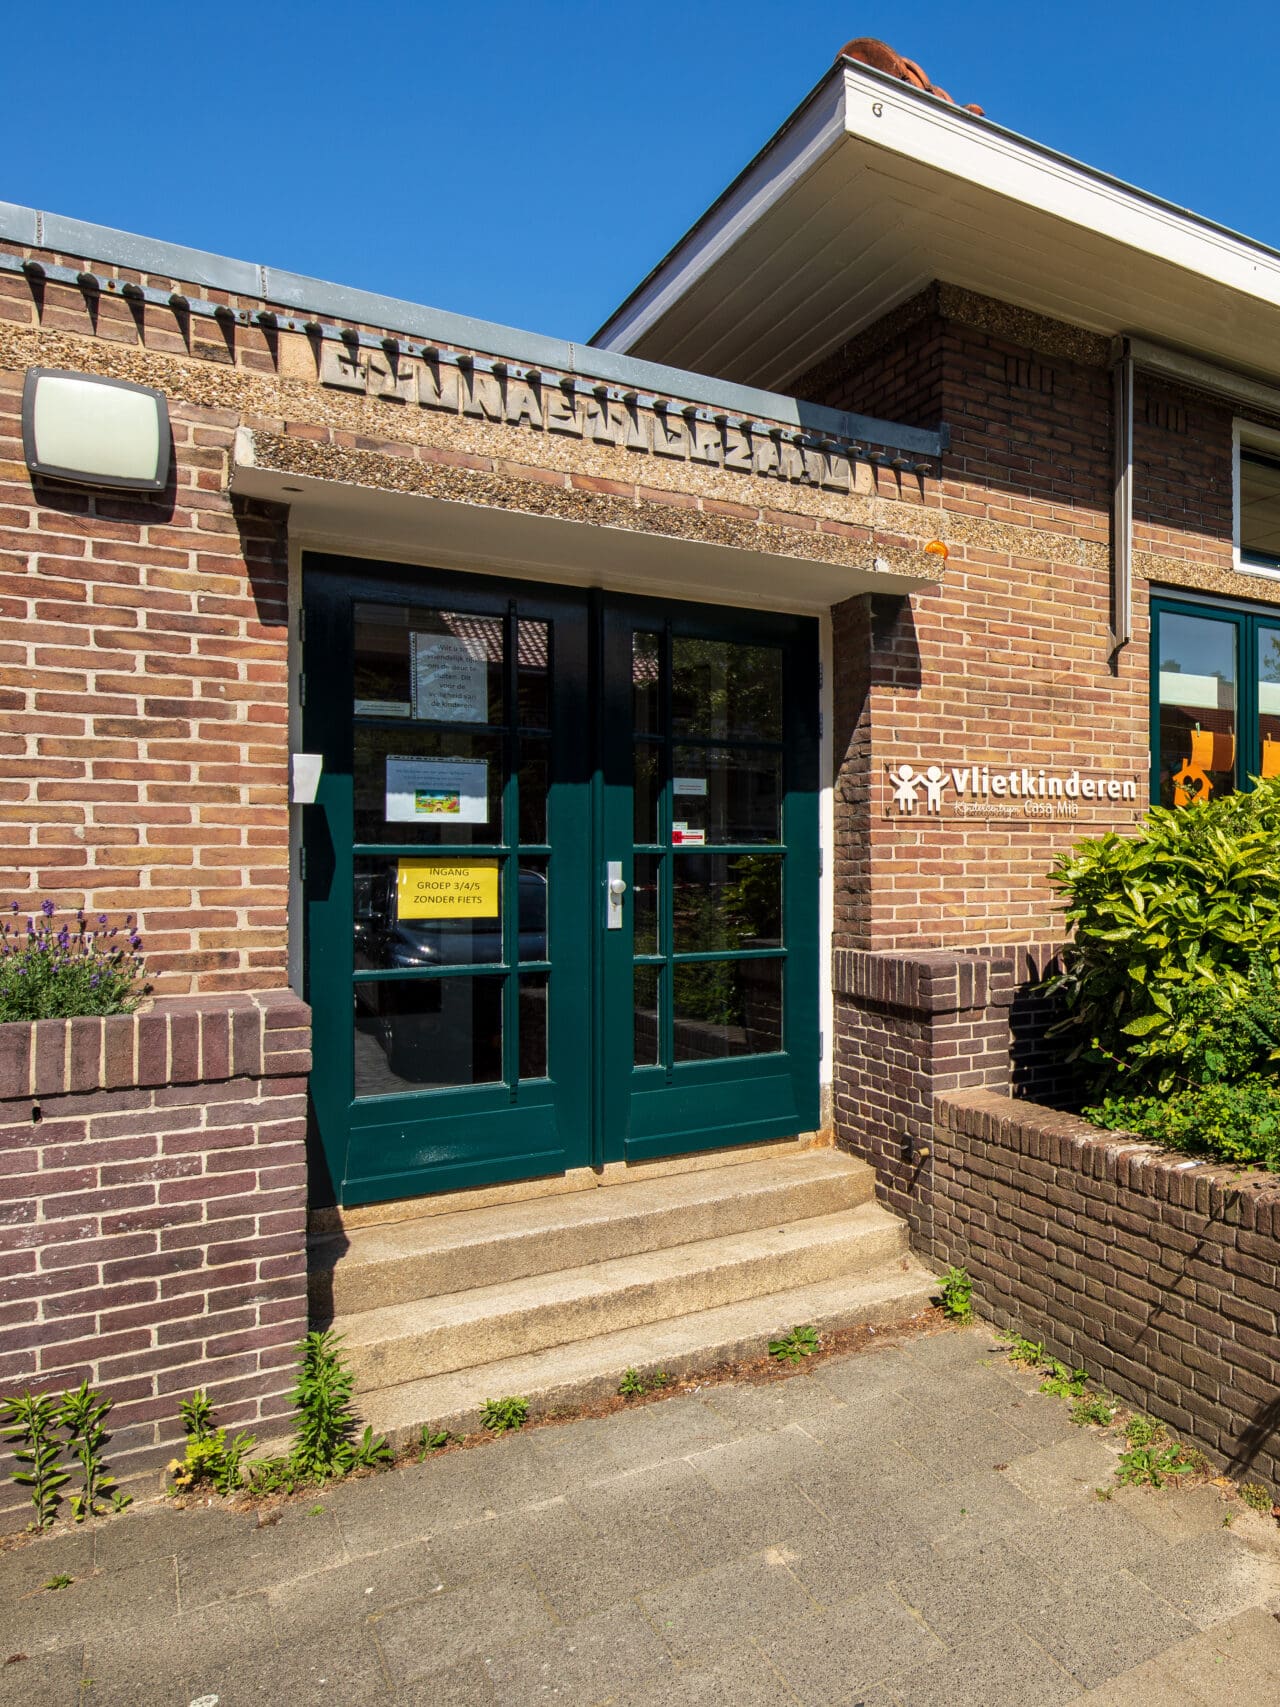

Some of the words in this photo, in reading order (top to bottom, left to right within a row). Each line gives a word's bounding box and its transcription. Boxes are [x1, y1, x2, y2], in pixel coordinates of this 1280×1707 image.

[951, 766, 1136, 800] Vlietkinderen
[1023, 800, 1053, 815] Casa
[1056, 801, 1080, 815] Mia
[429, 867, 470, 877] INGANG
[416, 881, 451, 890] GROEP
[453, 882, 481, 891] 3/4/5
[413, 895, 455, 904] ZONDER
[457, 896, 483, 904] FIETS
